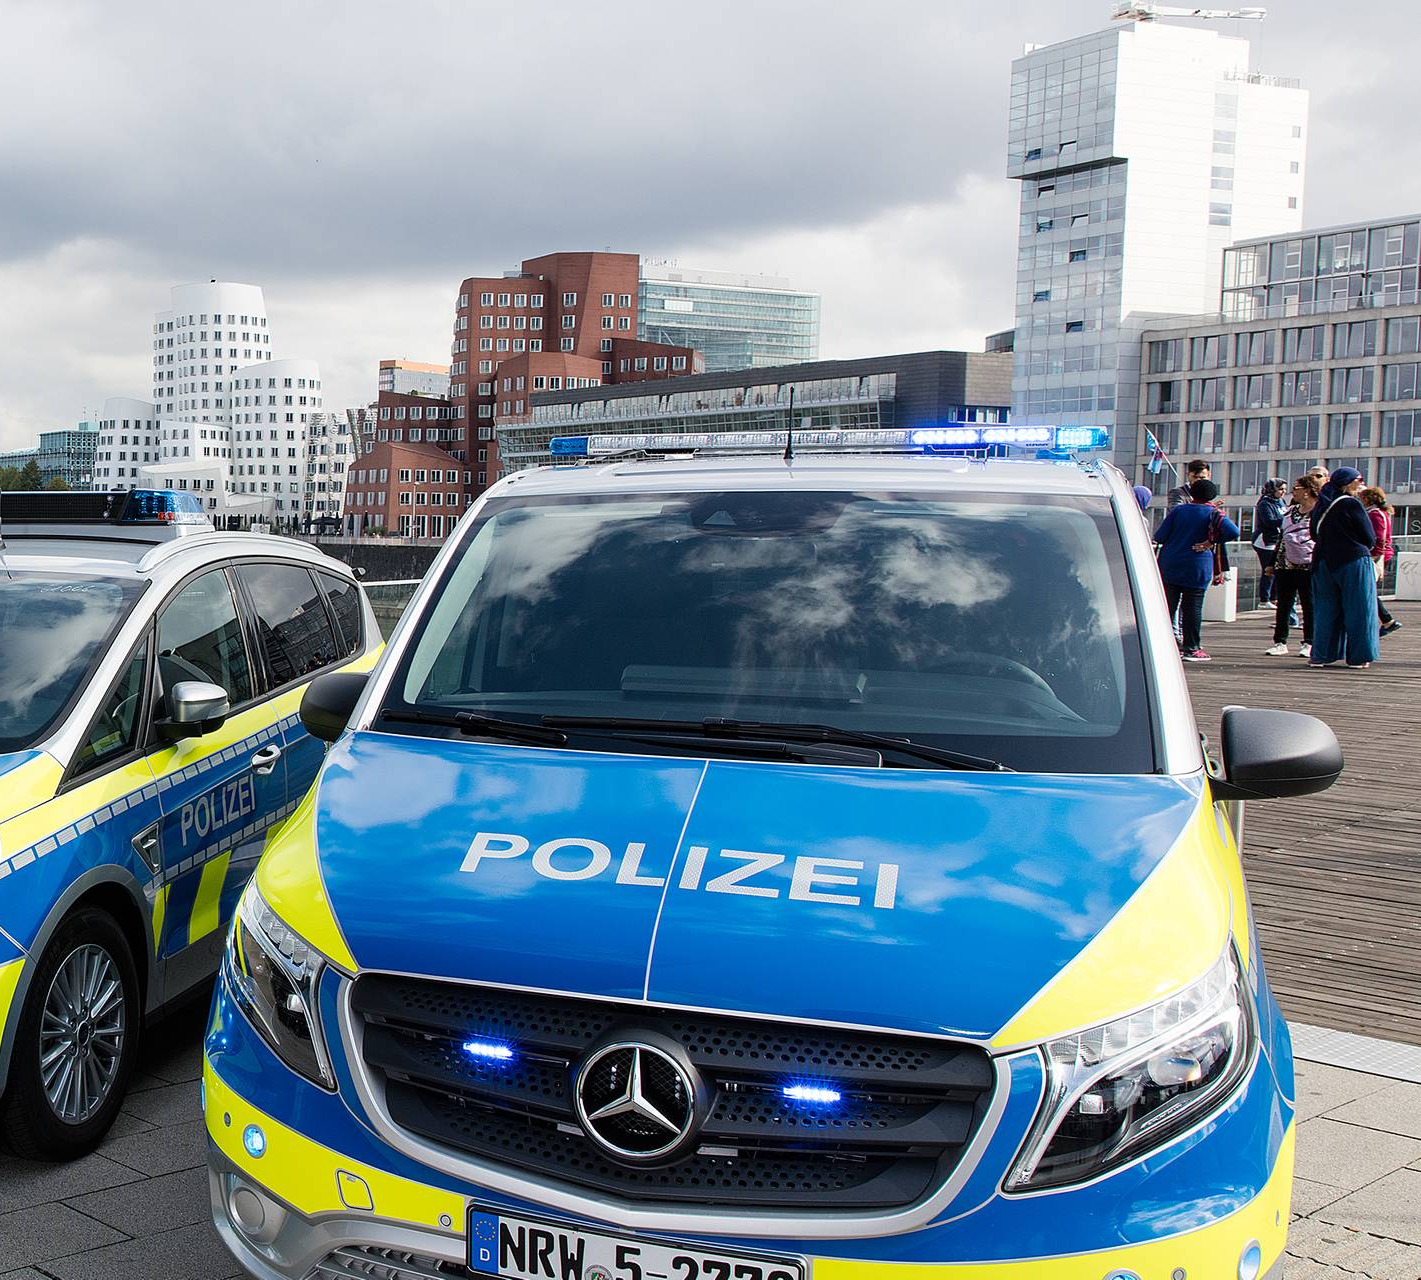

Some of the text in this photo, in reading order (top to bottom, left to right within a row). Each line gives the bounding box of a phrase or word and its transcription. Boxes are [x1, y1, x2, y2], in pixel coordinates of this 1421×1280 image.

[180, 773, 256, 848] POLIZEI
[459, 831, 900, 910] POLIZEI
[479, 1247, 490, 1262] D
[498, 1222, 586, 1280] NRW
